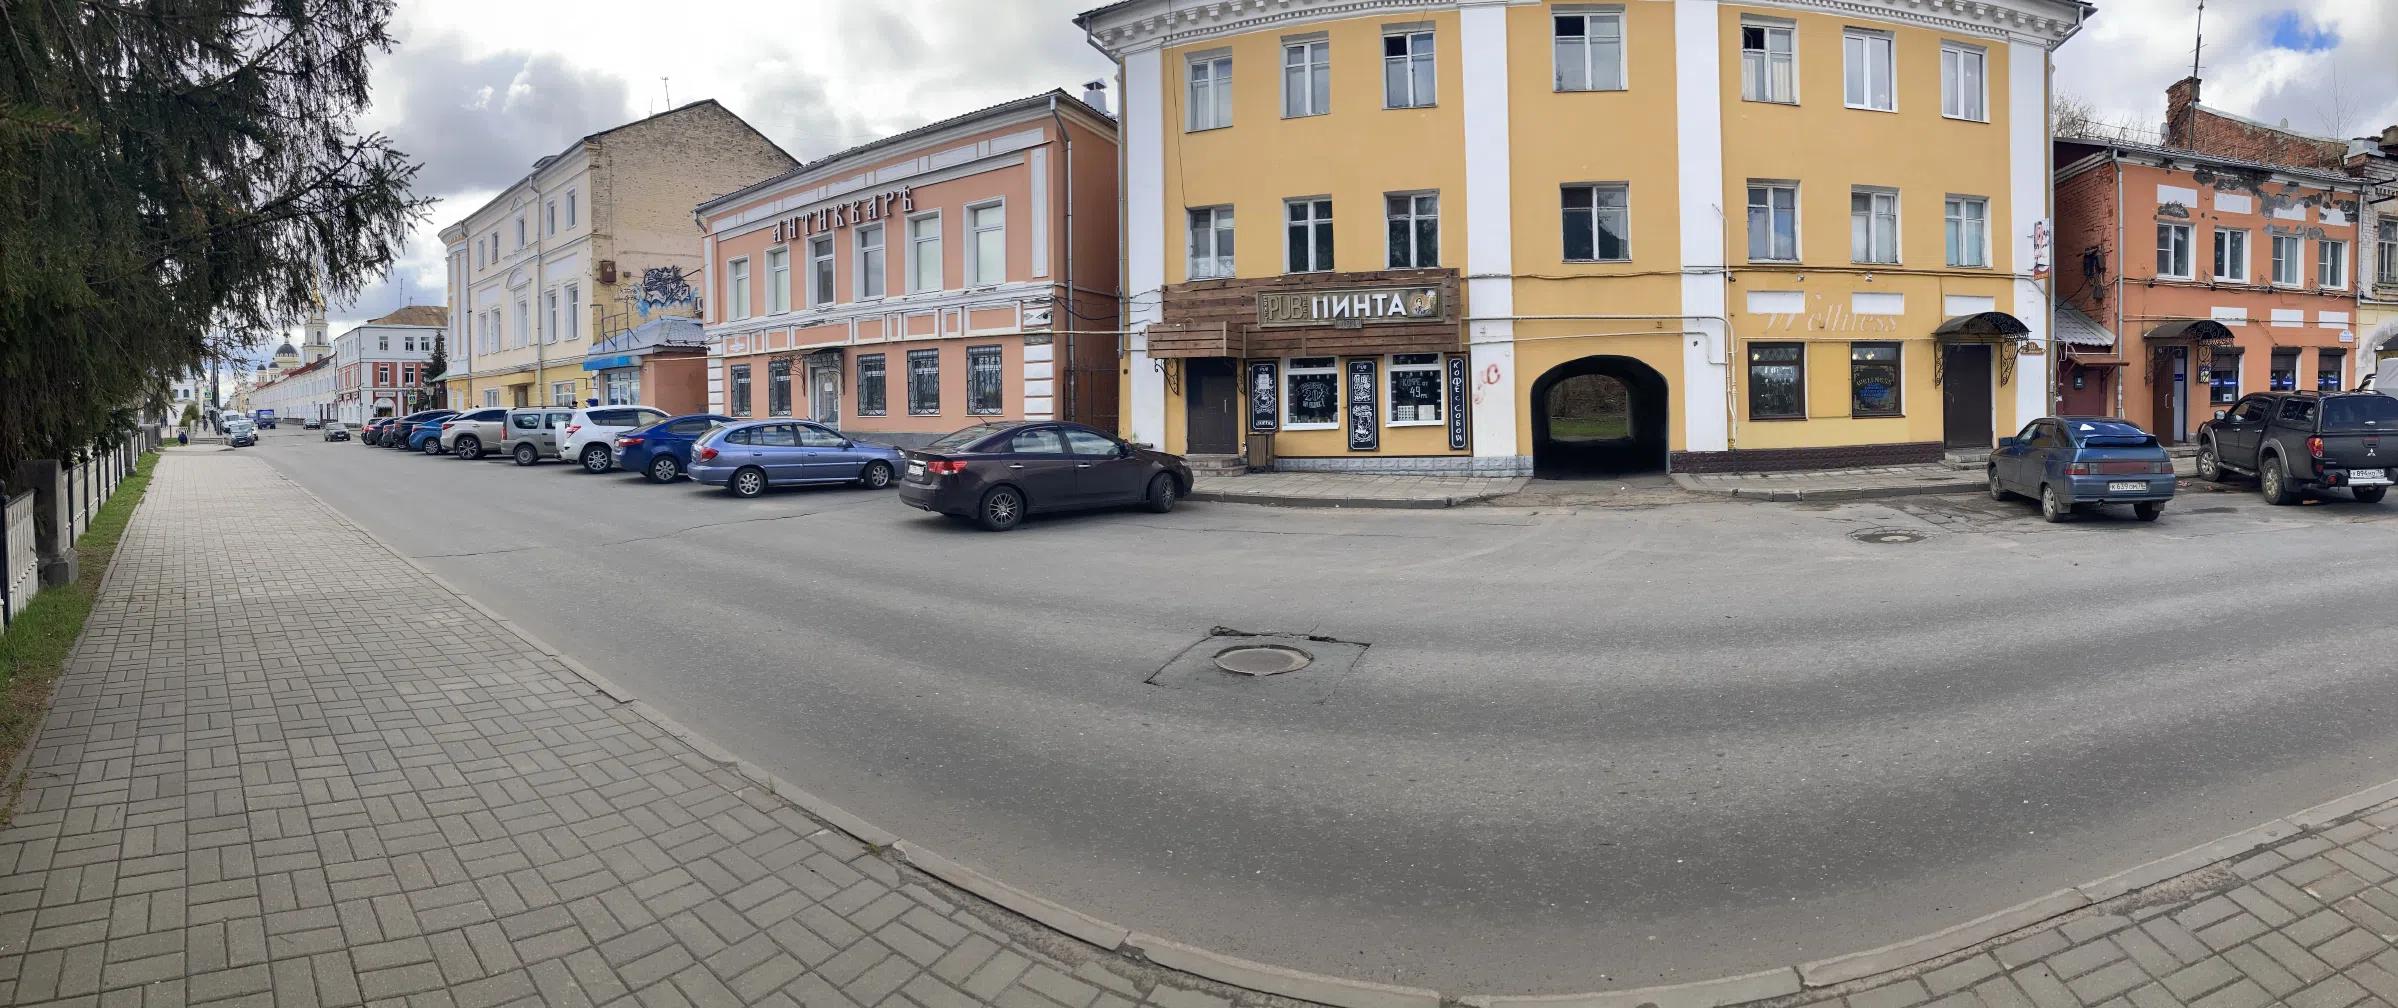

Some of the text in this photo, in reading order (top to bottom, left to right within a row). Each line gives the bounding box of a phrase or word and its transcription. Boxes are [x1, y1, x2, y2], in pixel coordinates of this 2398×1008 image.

[1268, 295, 1303, 320] PUB
[1311, 293, 1407, 319] ПИНТА
[1409, 386, 1421, 398] 49
